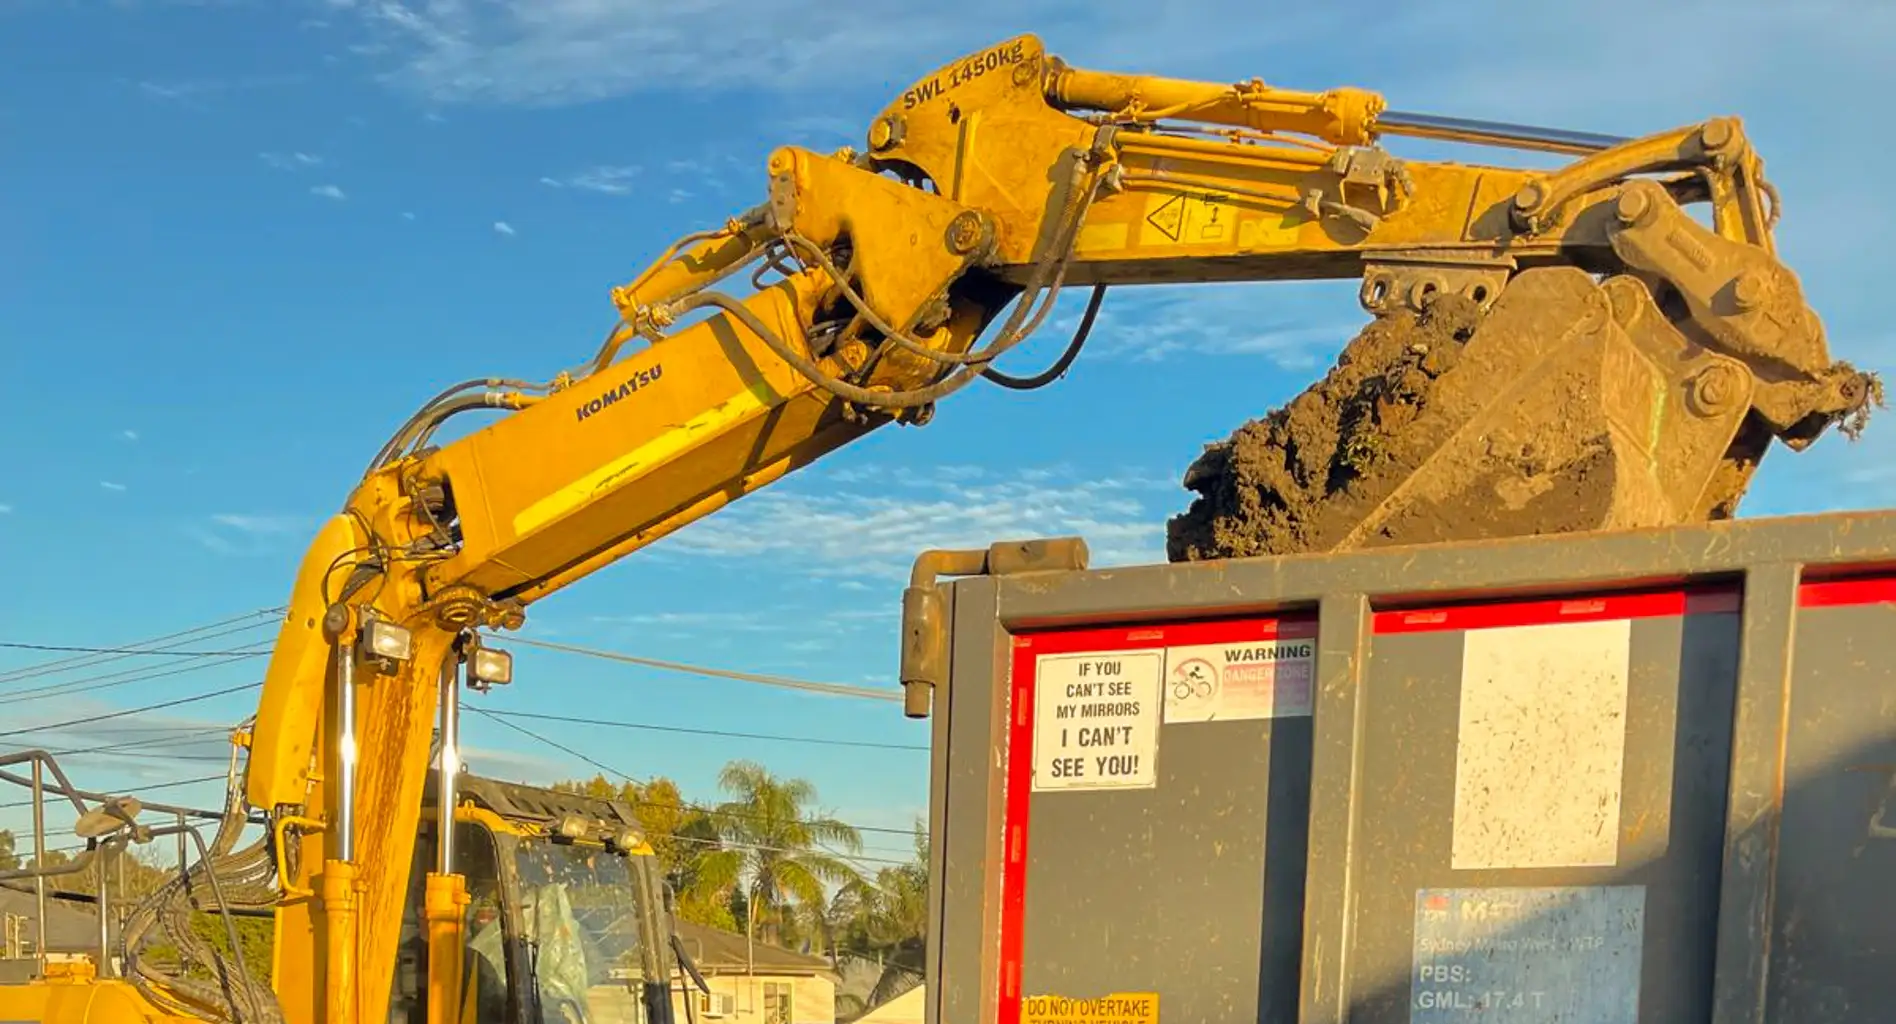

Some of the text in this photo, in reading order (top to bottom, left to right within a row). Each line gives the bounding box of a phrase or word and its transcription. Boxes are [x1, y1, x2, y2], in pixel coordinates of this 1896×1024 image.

[904, 40, 1024, 110] SWL 1450kg
[576, 364, 663, 422] KOMATSU
[1224, 644, 1311, 662] WARNING
[1078, 661, 1121, 677] IF YOU
[1066, 681, 1132, 698] CAN'T SEE
[1056, 701, 1140, 719] MY MIRRORS
[1061, 726, 1133, 748] I CAN'T
[1051, 755, 1139, 778] SEE YOU!
[1420, 965, 1471, 982] PBS:
[1027, 999, 1150, 1017] DO NOT OVERTAKE
[1531, 991, 1545, 1009] T
